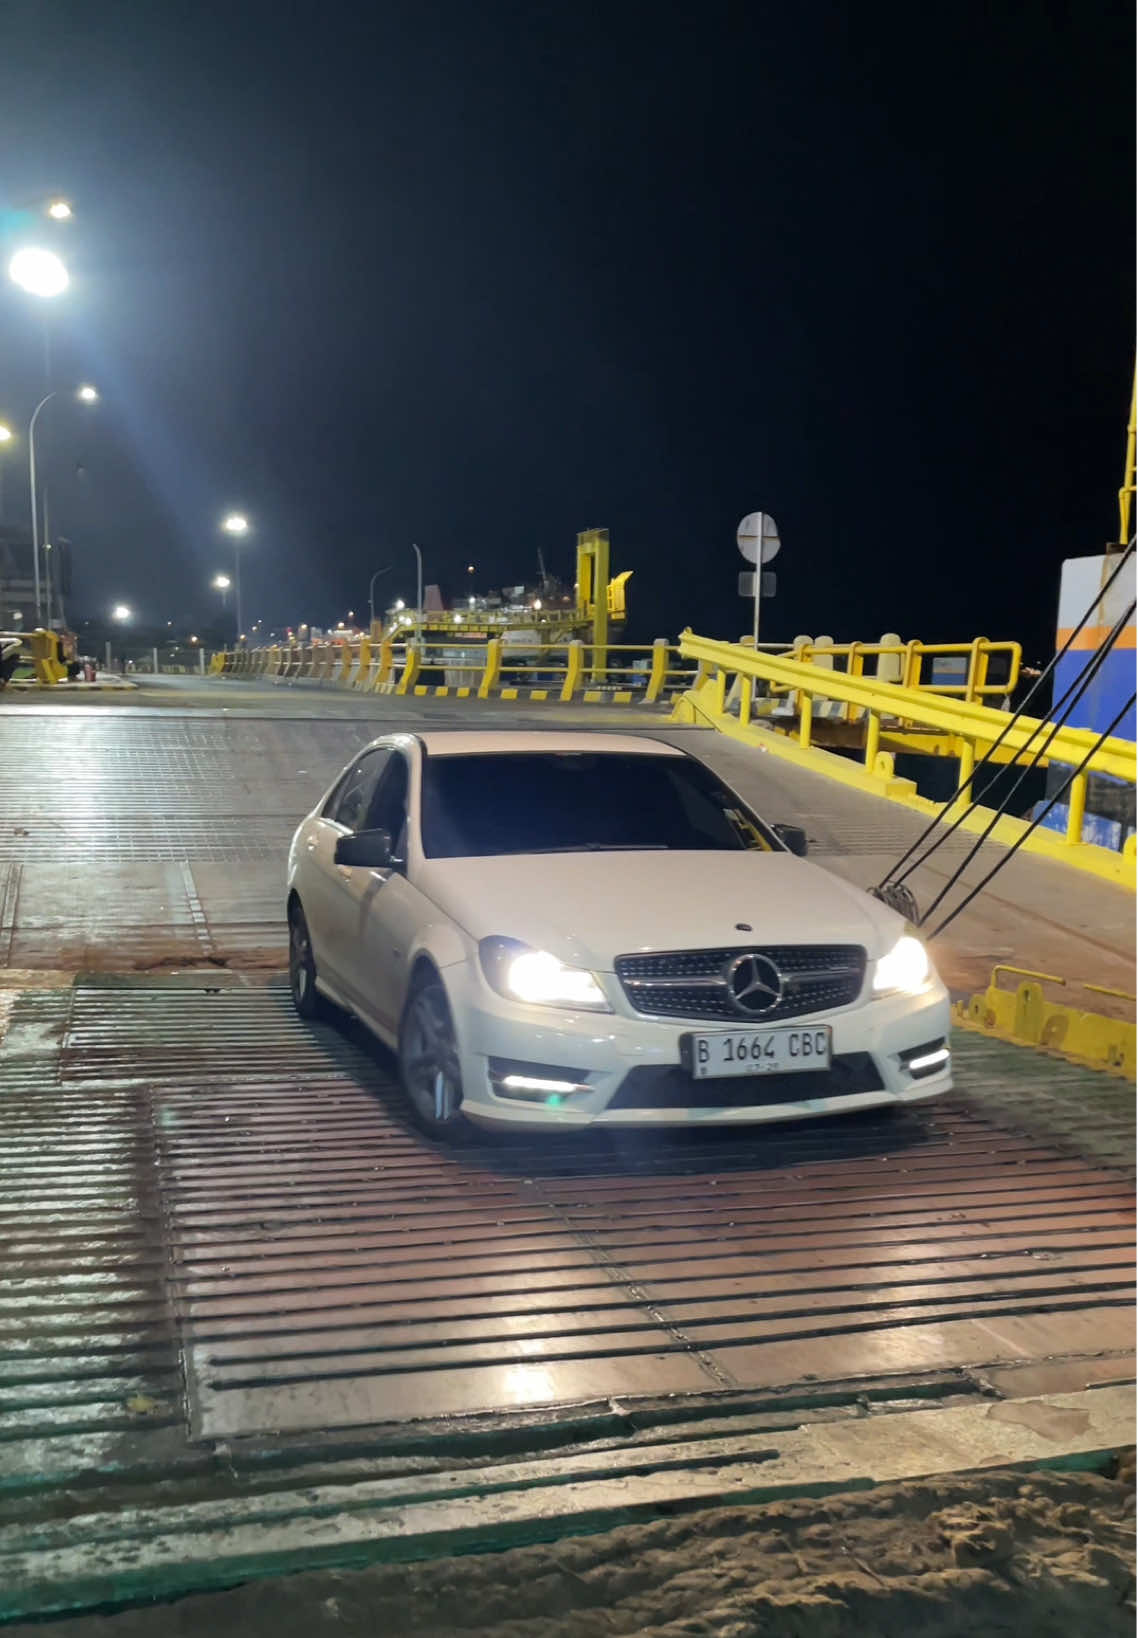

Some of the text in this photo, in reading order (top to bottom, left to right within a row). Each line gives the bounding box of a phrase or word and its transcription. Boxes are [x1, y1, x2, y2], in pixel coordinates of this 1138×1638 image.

[698, 1032, 826, 1063] B 1664 CBC
